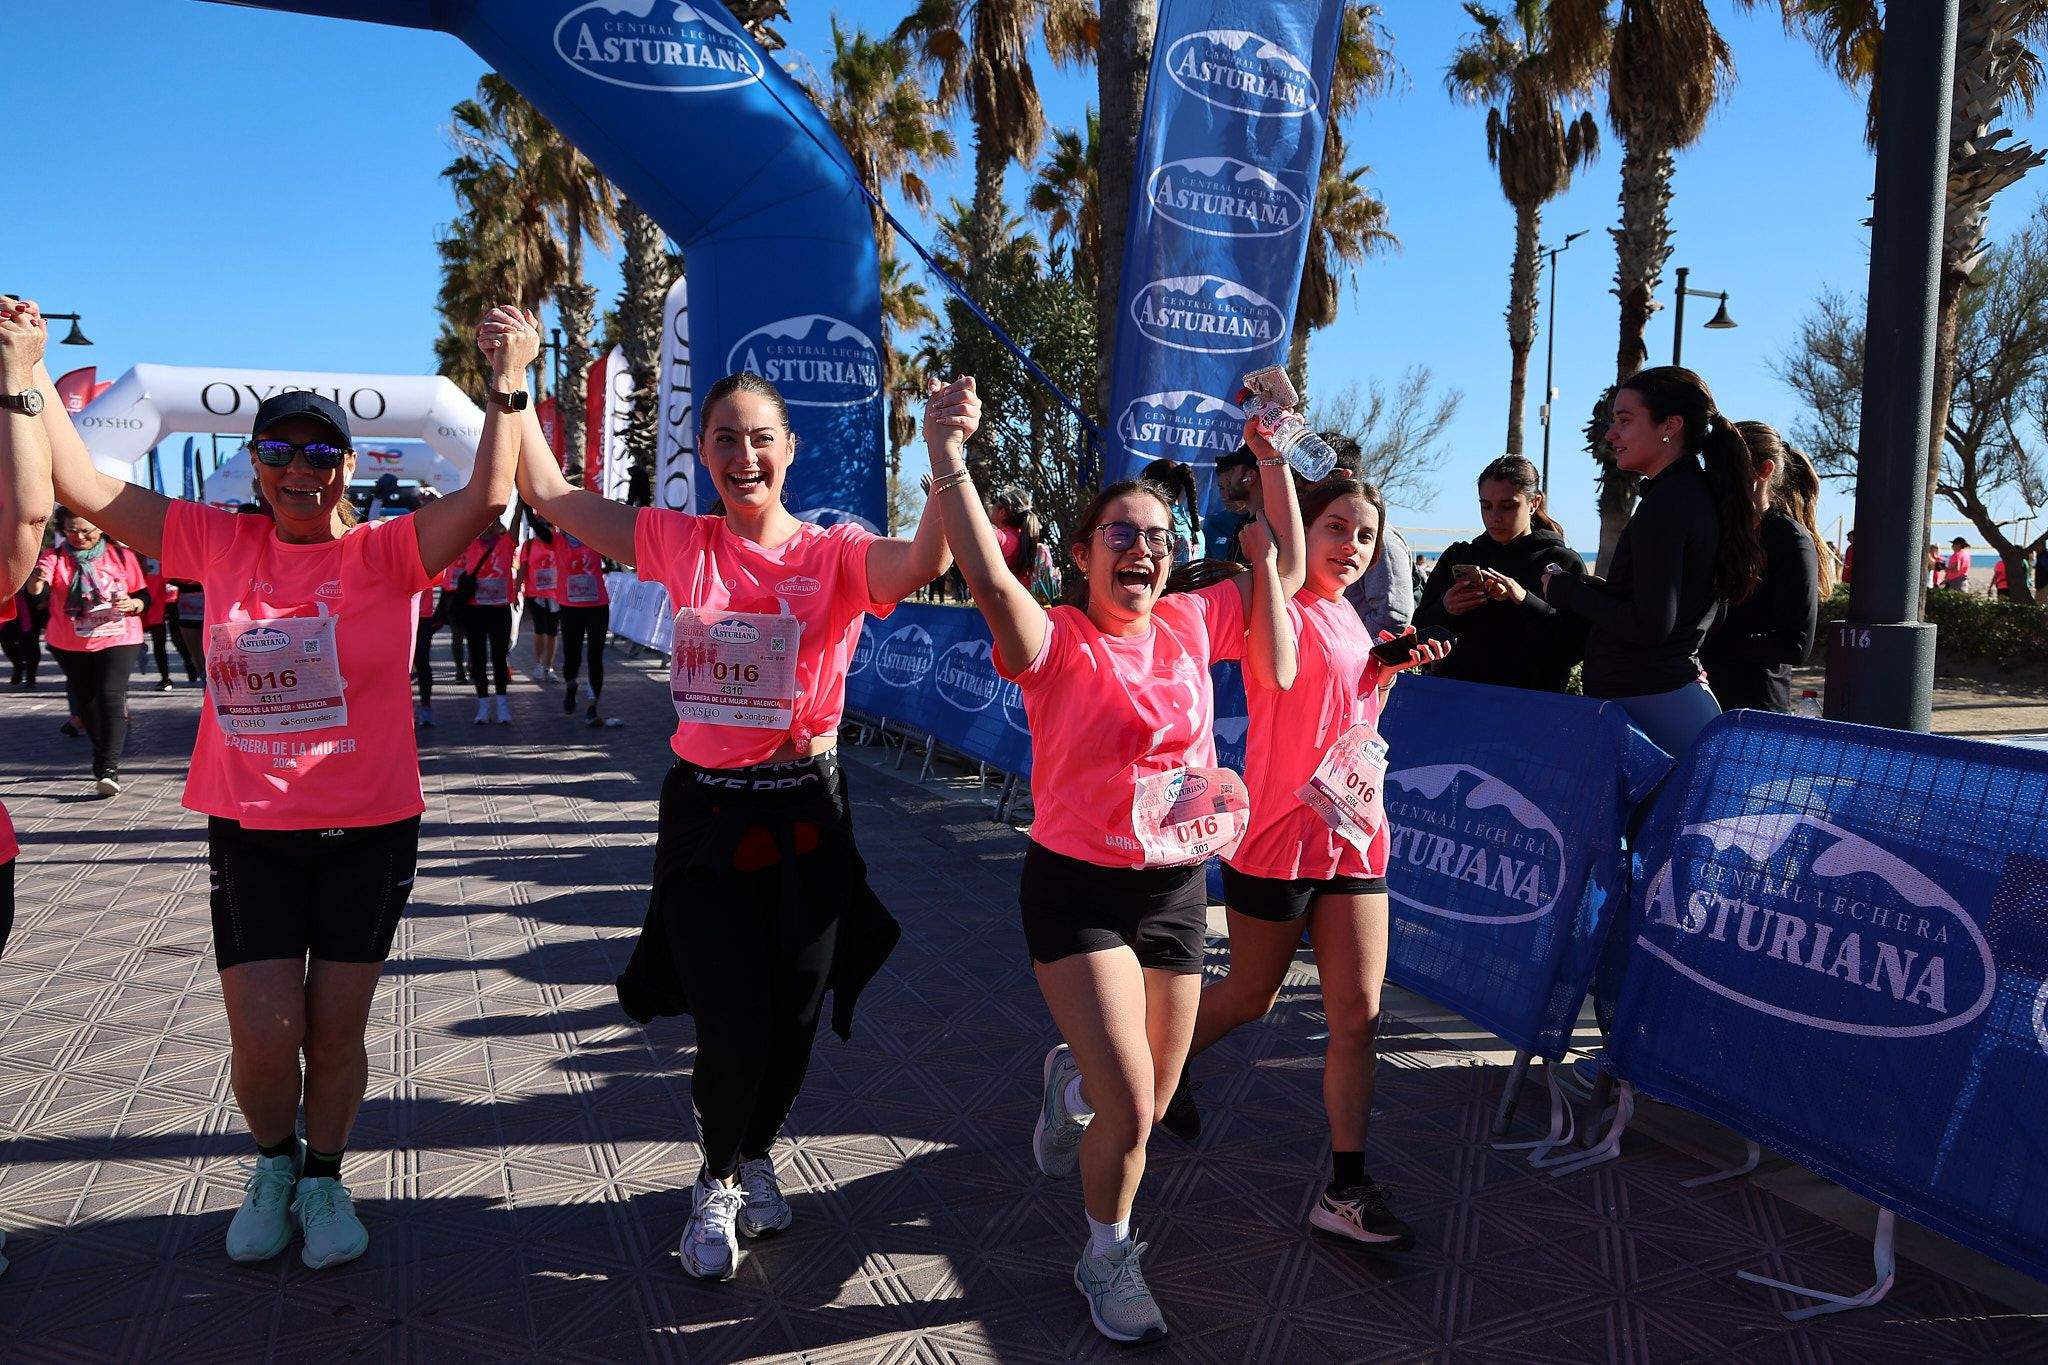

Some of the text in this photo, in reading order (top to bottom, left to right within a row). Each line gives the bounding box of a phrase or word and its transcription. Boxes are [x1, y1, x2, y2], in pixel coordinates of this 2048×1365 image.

[604, 21, 674, 37] CENTRAL
[572, 22, 751, 74] ASTURIANA
[1175, 46, 1307, 108] ASTURIANA
[1155, 175, 1290, 227] ASTURIANA
[1162, 296, 1213, 310] CENTRAL
[1140, 294, 1271, 339] ASTURIANA
[767, 345, 827, 356] CENTRAL
[743, 348, 878, 387] ASTURIANA
[201, 382, 385, 420] OYO
[82, 416, 144, 431] OYSHO
[1144, 411, 1242, 430] CENTRAL LECHER
[438, 426, 481, 437] OYSH
[239, 637, 287, 648] ASTURIANA
[712, 628, 757, 640] ASTURIANA
[1839, 628, 1871, 649] 116
[247, 669, 298, 691] 016
[713, 662, 759, 682] 016
[938, 657, 995, 699] ASTURIANA
[261, 694, 283, 703] 4311
[685, 693, 711, 702] CARRERA
[728, 698, 748, 706] MUJER
[753, 699, 782, 707] VALENCIA
[721, 686, 743, 695] 4310
[229, 706, 252, 714] CARRERA
[271, 704, 292, 712] MUJER
[296, 701, 327, 710] VALENCIA
[682, 706, 782, 723] OYSHO Santander
[231, 714, 332, 728] OYSHO Santander
[272, 741, 288, 756] DE
[291, 742, 307, 756] LA
[310, 738, 356, 756] MUJER
[694, 771, 748, 789] IKE
[1346, 772, 1375, 803] 016
[1168, 782, 1206, 800] ASTURIANA
[1176, 815, 1218, 844] 016
[1390, 800, 1457, 830] CENTRAL
[1463, 819, 1546, 857] LECHERA
[1390, 822, 1539, 908] TURIANA
[1700, 862, 1949, 944] CENTRAL LECHERA
[1644, 858, 1949, 1014] ASTURIANA
